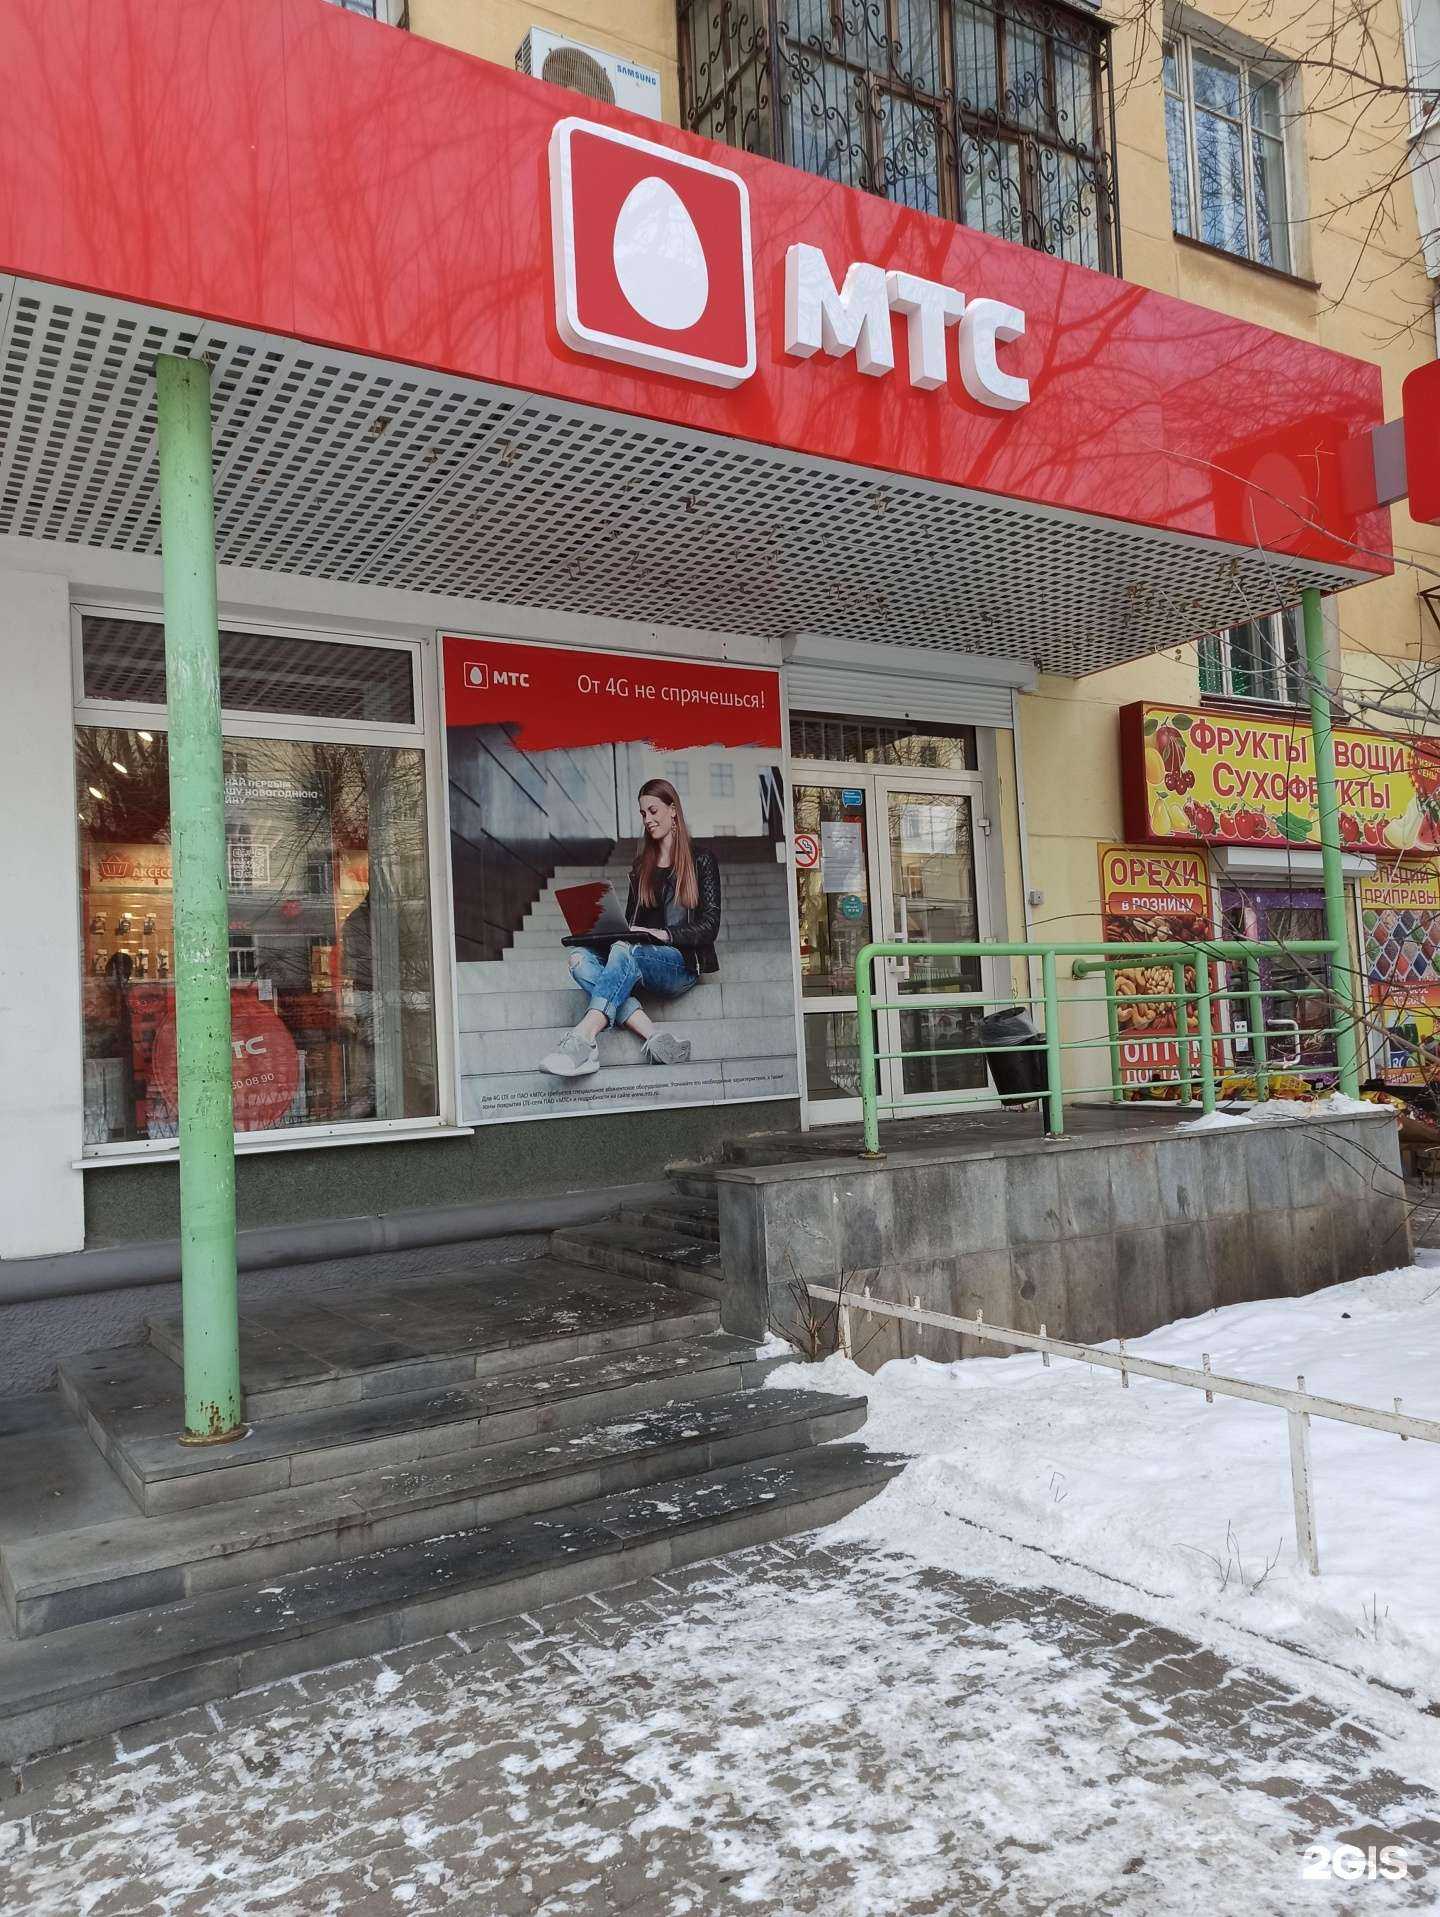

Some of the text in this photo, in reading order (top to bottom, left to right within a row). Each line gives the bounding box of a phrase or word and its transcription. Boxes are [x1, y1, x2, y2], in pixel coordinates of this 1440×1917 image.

[616, 64, 657, 86] SAMSUNG
[785, 242, 1030, 411] МТС
[492, 670, 531, 688] МТС
[577, 674, 766, 709] От 4G не спрячешься!
[1189, 718, 1406, 772] ФРУКТЫ ВОЩИ
[224, 777, 246, 786] НАЙ
[1212, 761, 1391, 809] СУХОФРКТЫ
[245, 788, 318, 799] НОВОГОДНЮЮ
[1110, 857, 1200, 887] ОРЕХИ
[1131, 897, 1194, 913] РОЗНИЦУ
[1364, 888, 1438, 905] ПРИПРАВЫ
[231, 1036, 268, 1059] ТС
[245, 1076, 260, 1086] 08
[260, 1072, 275, 1083] 90
